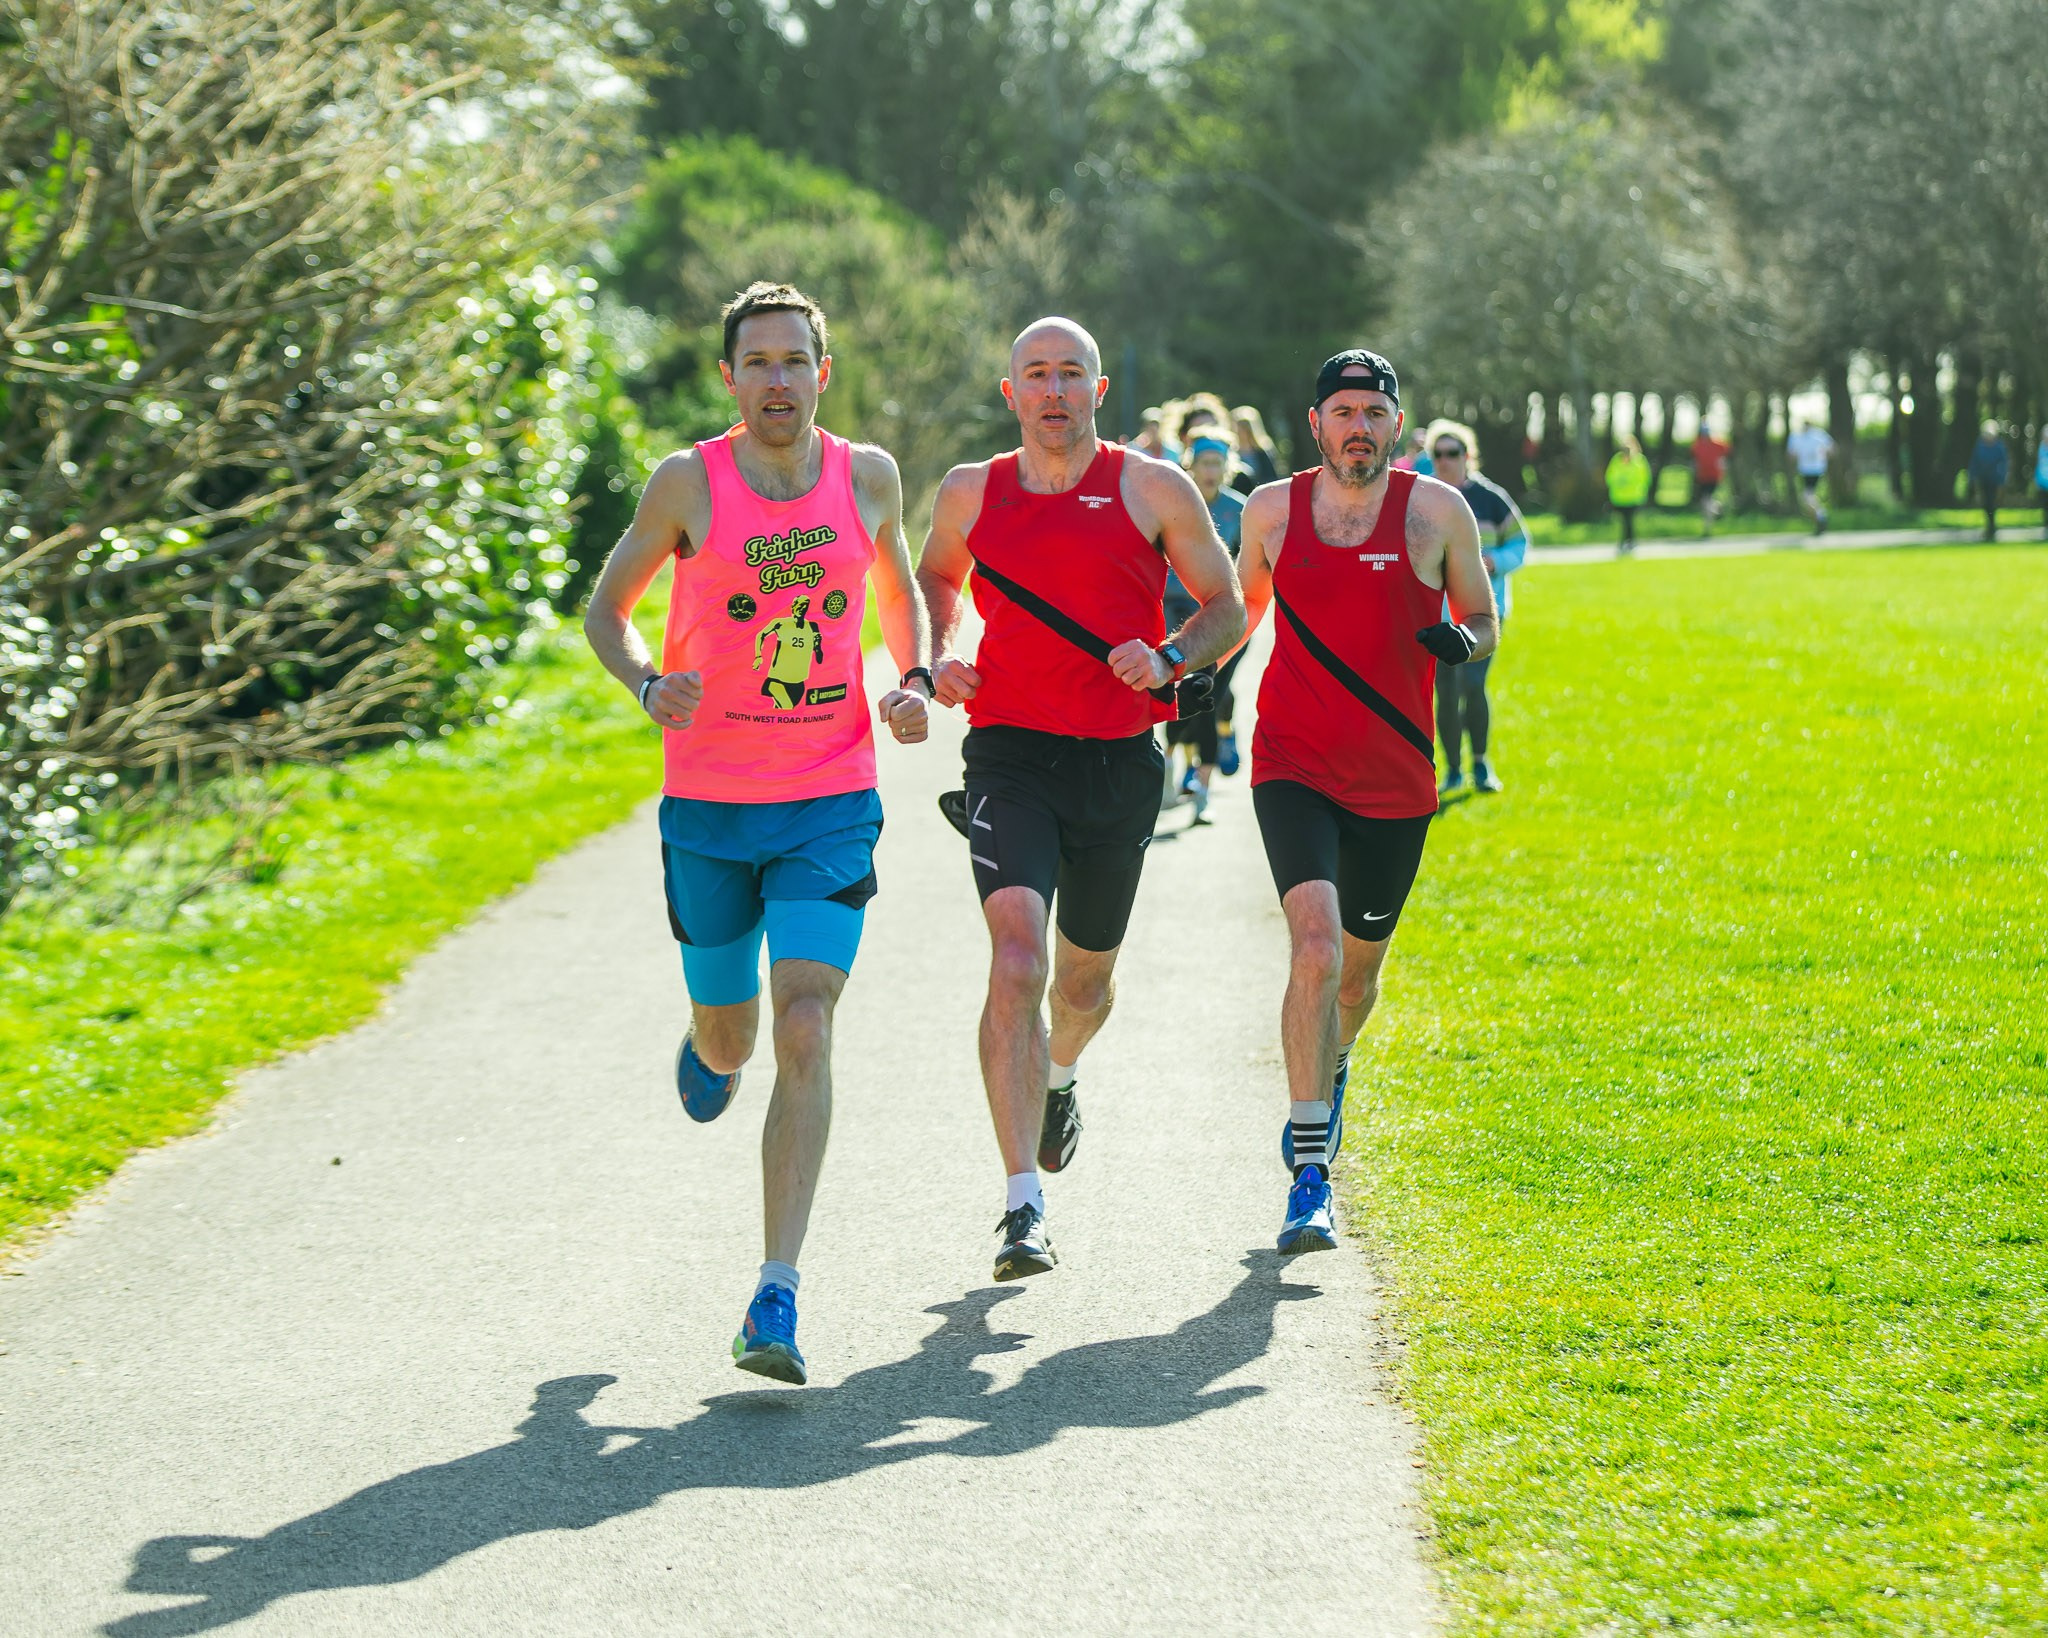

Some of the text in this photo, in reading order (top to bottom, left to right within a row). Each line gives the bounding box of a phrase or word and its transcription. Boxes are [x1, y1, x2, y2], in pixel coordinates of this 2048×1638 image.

[744, 525, 837, 566] Feighan
[1359, 553, 1399, 561] WIMBORNE
[1372, 561, 1385, 570] AC
[759, 562, 825, 594] Fury
[791, 637, 804, 649] 25
[725, 711, 835, 724] SOUTH WEST ROAD RUNNERS
